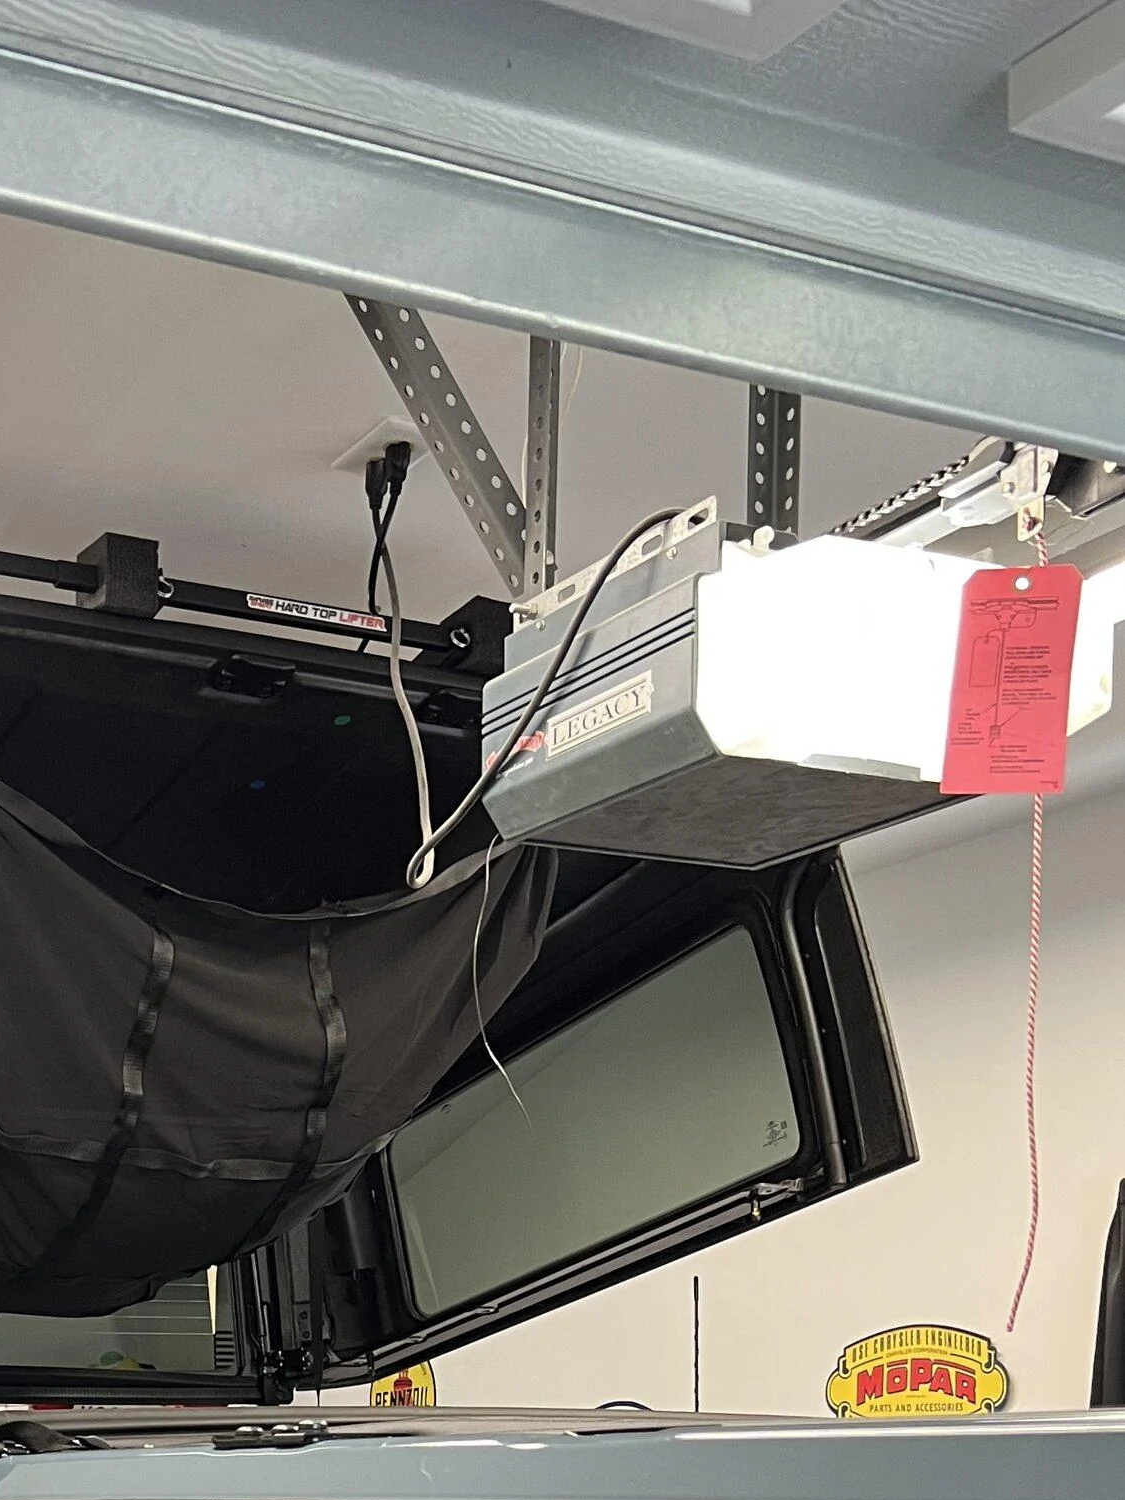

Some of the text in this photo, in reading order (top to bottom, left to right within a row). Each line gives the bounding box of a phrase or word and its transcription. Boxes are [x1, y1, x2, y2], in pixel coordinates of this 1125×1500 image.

[275, 600, 308, 615] HARD
[312, 607, 337, 620] TOP
[339, 612, 385, 629] LIFTER
[551, 686, 645, 746] LEGACY
[852, 1329, 983, 1362] USE CHRYSLER ENGINEERED
[869, 1401, 964, 1413] PARTS AND ACCESSORIES
